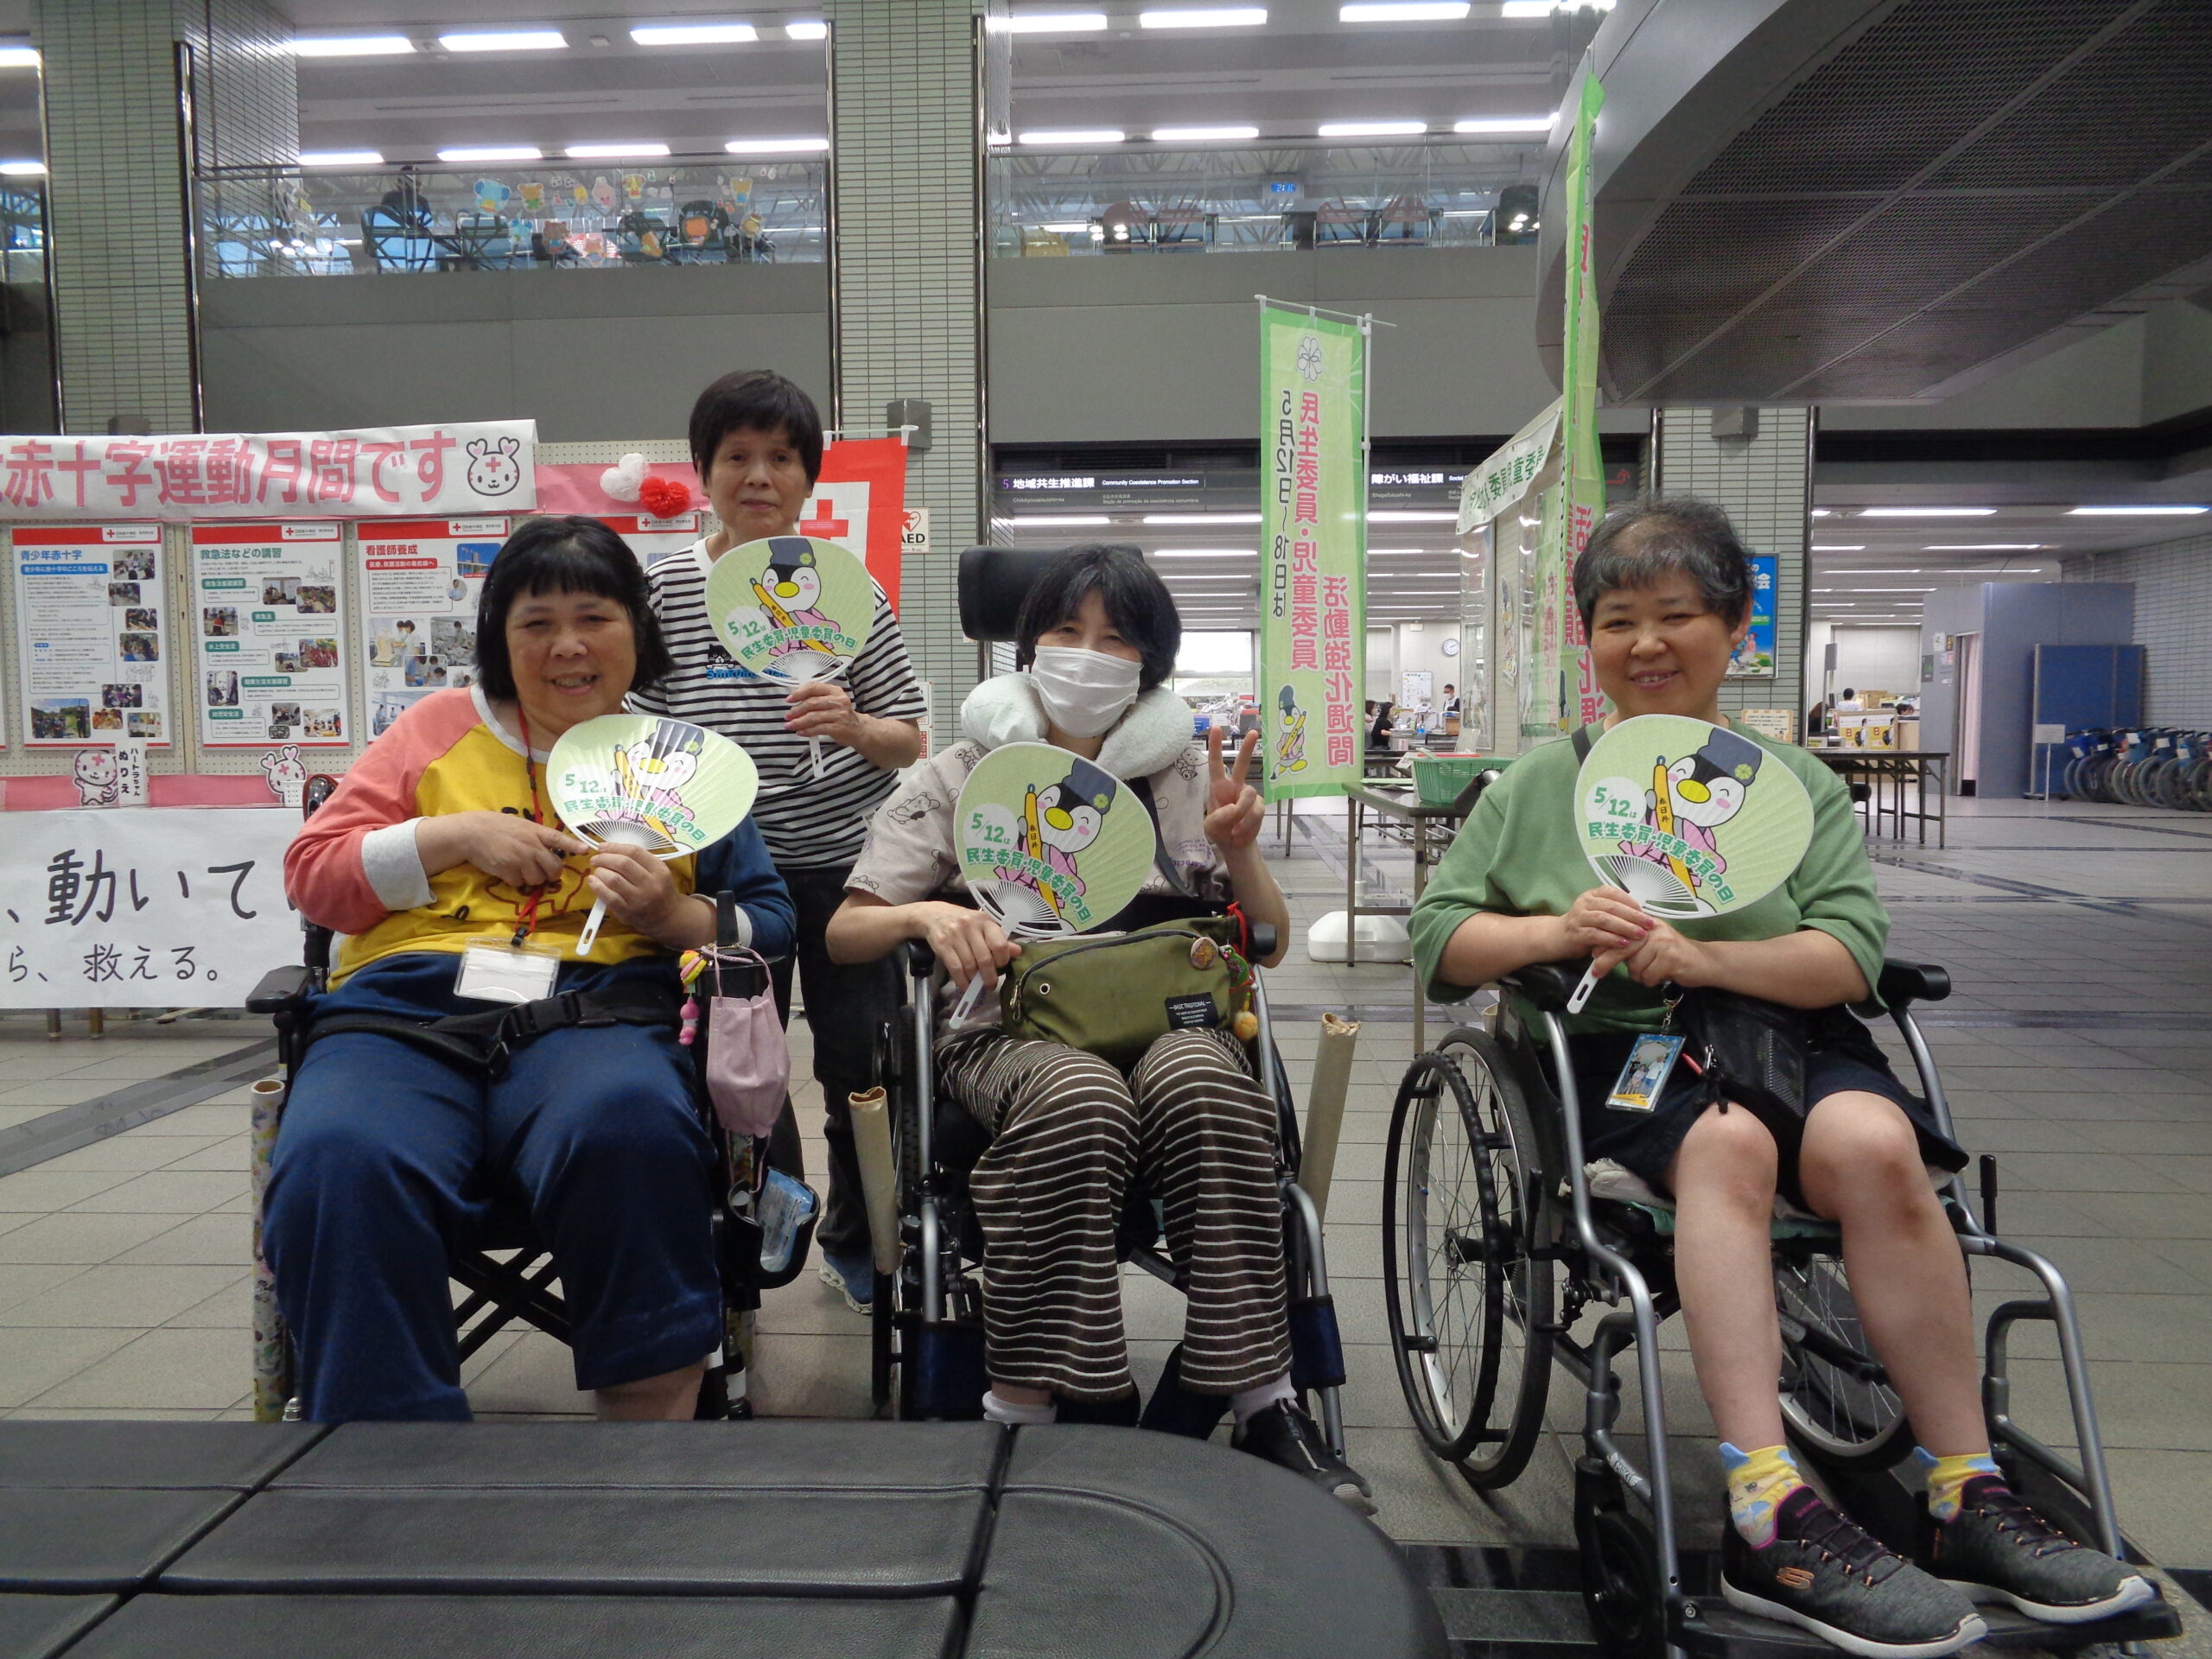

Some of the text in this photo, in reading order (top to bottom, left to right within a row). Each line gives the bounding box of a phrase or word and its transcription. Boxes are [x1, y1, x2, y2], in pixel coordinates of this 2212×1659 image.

[0, 430, 456, 508] 赤十字運動月間です
[1013, 478, 1095, 489] 地域共生推進課
[1371, 474, 1444, 484] 障がい福祉課
[21, 550, 82, 561] 青少年赤十字
[200, 548, 282, 560] 救急法などの講習
[365, 544, 418, 556] 看護師養成
[741, 626, 857, 661] 民生委員・児童委員の日
[119, 750, 130, 794] ぬりえ
[130, 748, 140, 796] ハートラちゃん
[1587, 822, 1736, 903] 民生委員・児童委員の日
[7, 849, 296, 926] 、動いて
[966, 847, 1092, 923] 民生委員・児童委員の日
